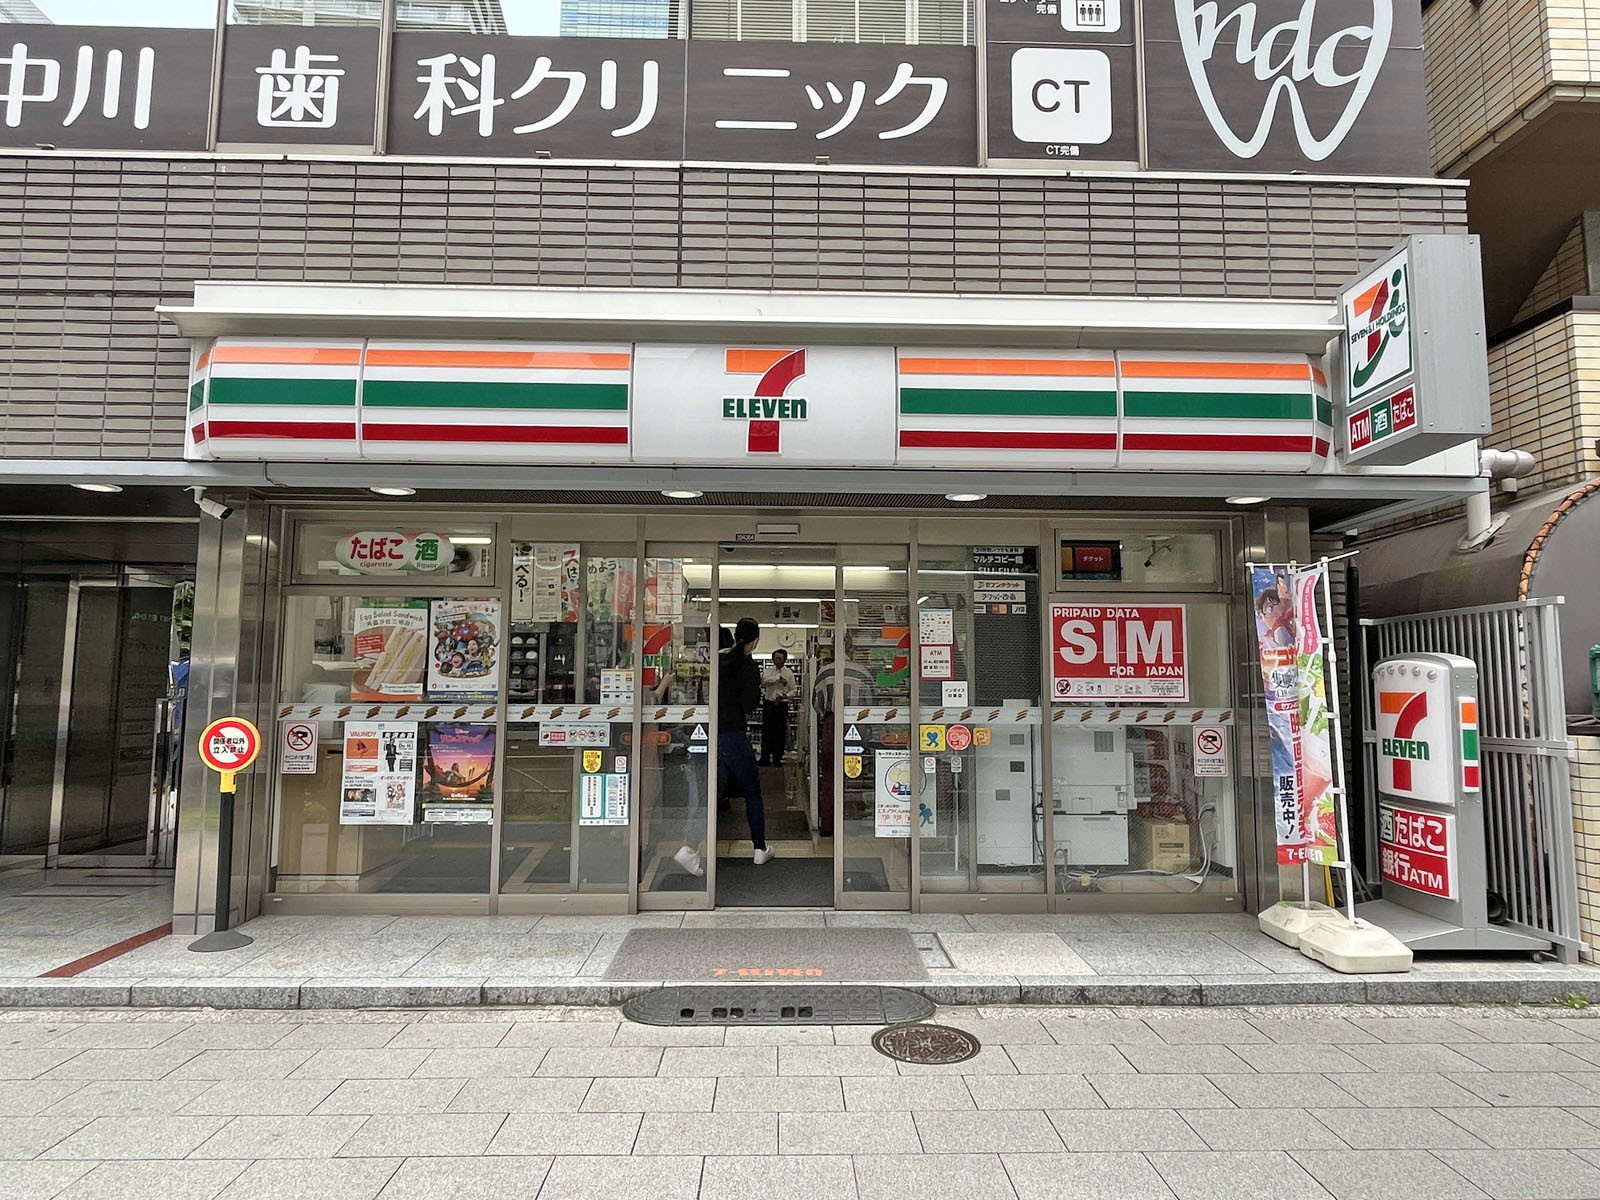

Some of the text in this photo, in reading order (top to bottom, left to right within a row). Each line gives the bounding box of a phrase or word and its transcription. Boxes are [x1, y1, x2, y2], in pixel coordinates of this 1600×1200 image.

[1032, 79, 1090, 113] CT
[1046, 145, 1080, 156] CT完備
[1376, 301, 1405, 328] HOLDINGS
[1351, 396, 1415, 445] ATM 酒 たばこ
[350, 537, 404, 560] たばこ
[414, 538, 439, 561] 酒
[974, 555, 1024, 564] マルチコピー機
[360, 611, 424, 622] Egg Salad Sandwich
[1053, 607, 1140, 618] PRIPAID DATA
[1059, 619, 1174, 664] SIM
[1109, 666, 1184, 676] FOR JAPAN
[213, 737, 245, 745] 関係者以外
[213, 746, 245, 754] 立入禁止
[1279, 775, 1297, 840] 販売中!
[1380, 807, 1445, 852] 酒 たばこ
